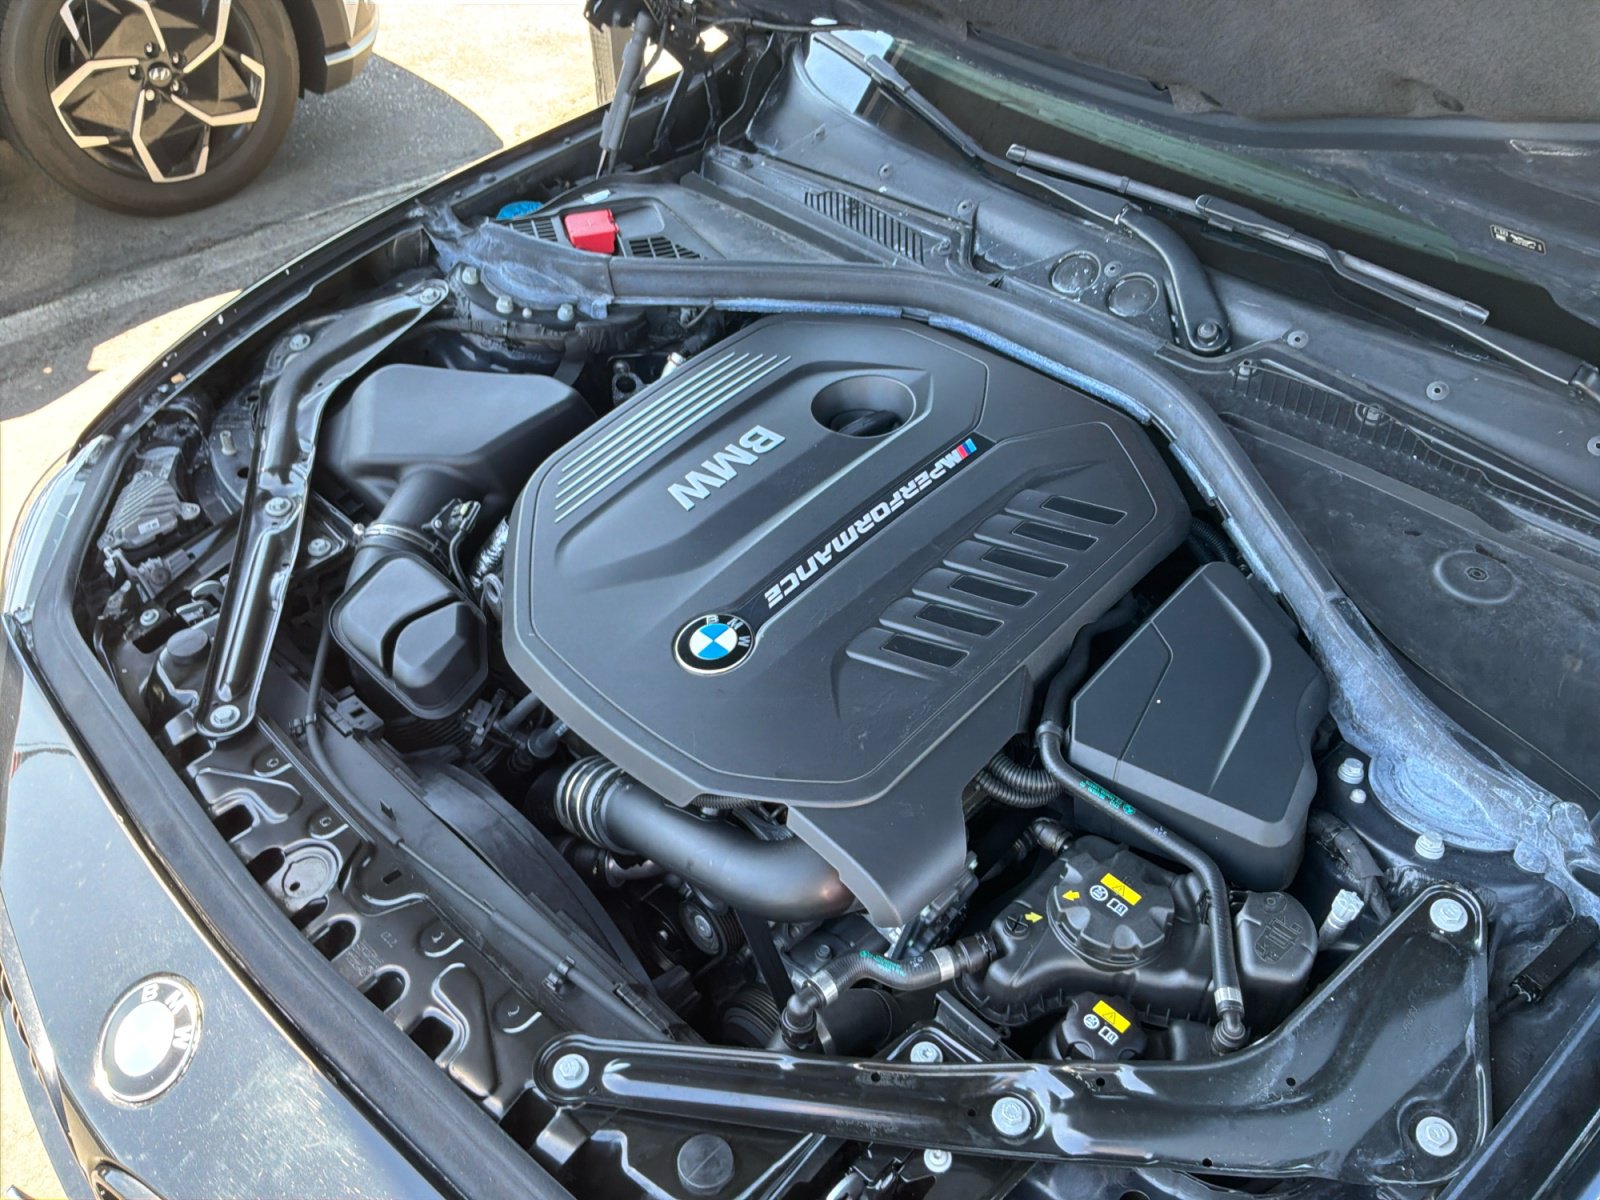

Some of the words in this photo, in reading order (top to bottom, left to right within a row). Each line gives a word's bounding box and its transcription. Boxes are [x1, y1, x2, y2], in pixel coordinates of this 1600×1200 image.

[667, 425, 785, 511] BMW
[706, 614, 751, 647] BMW
[141, 983, 192, 1050] BMW
